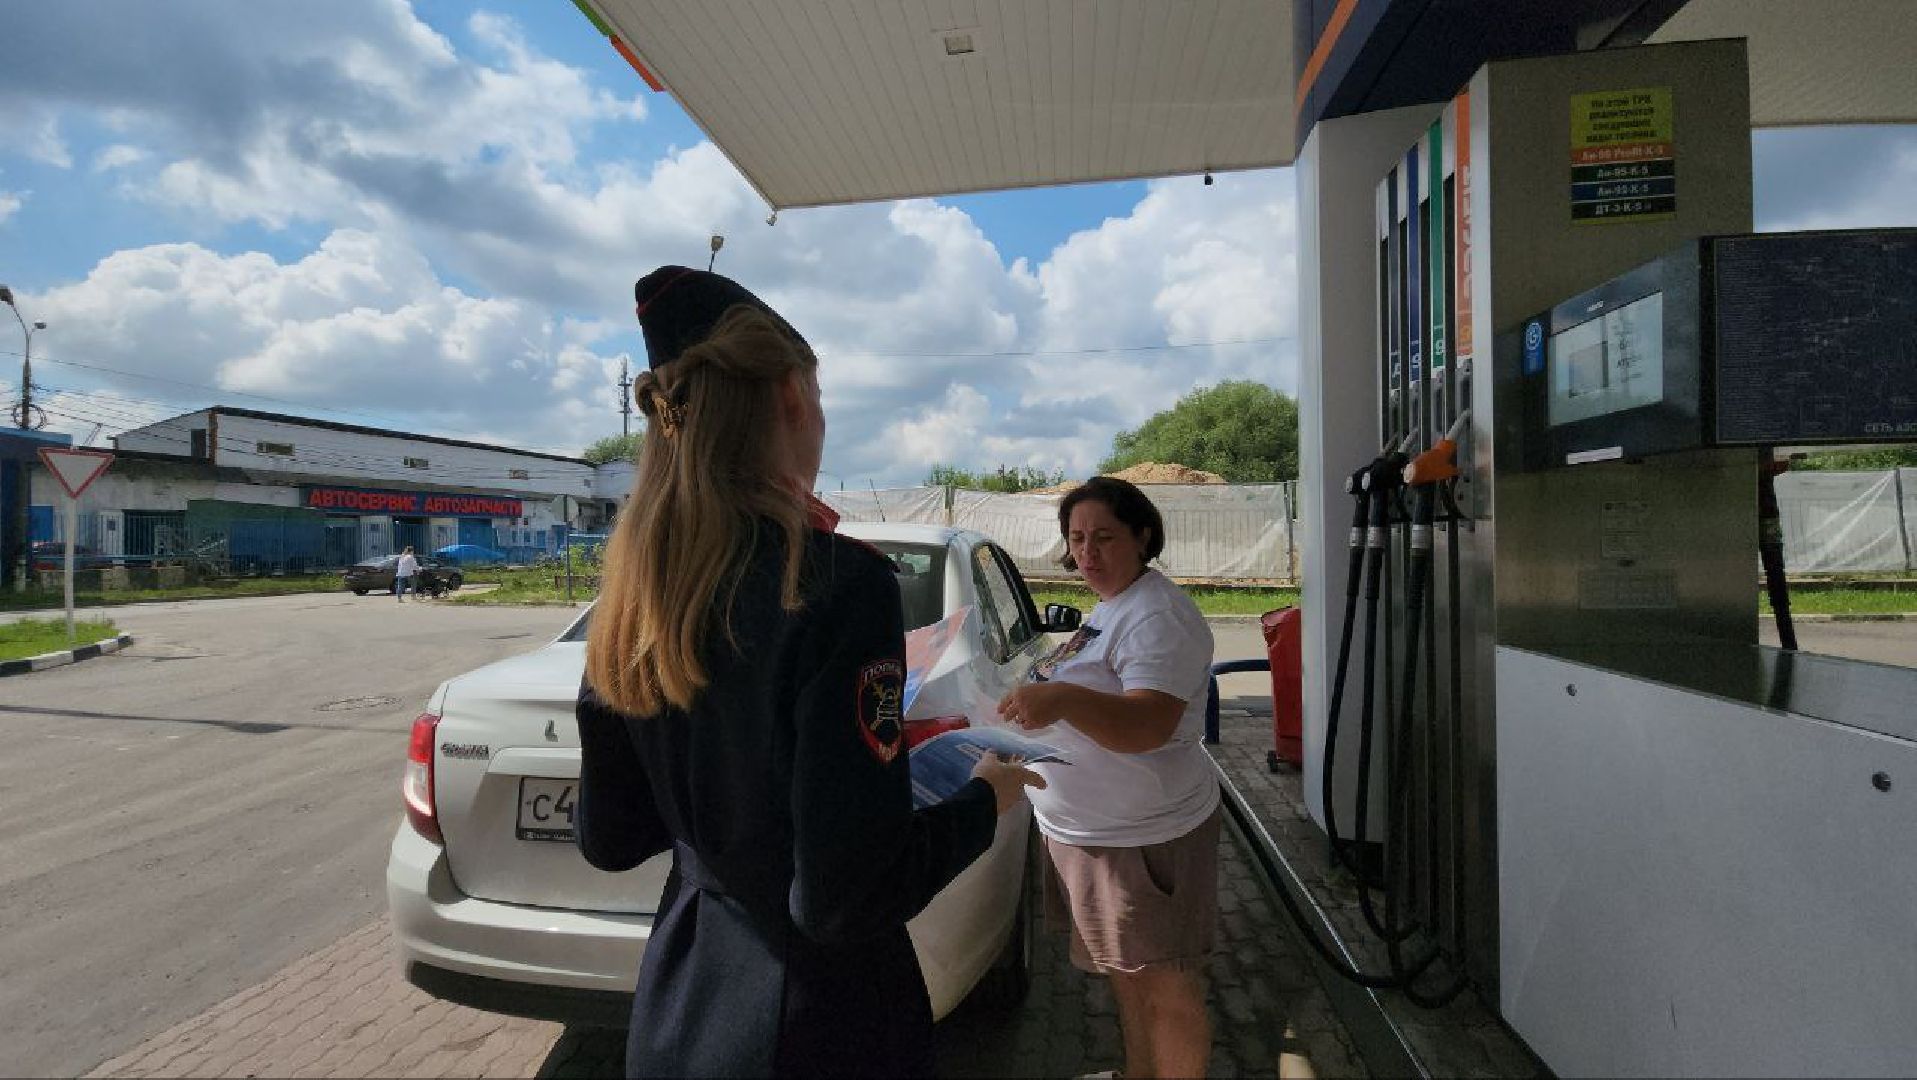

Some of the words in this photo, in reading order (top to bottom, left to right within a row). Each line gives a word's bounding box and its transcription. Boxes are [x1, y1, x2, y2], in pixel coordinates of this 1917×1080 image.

[1631, 94, 1652, 105] ТРК
[1864, 422, 1894, 433] СЕТЬ
[309, 488, 416, 511] АВТОСЕРВИС
[424, 496, 523, 515] АВТОЗАПЧАСТИ
